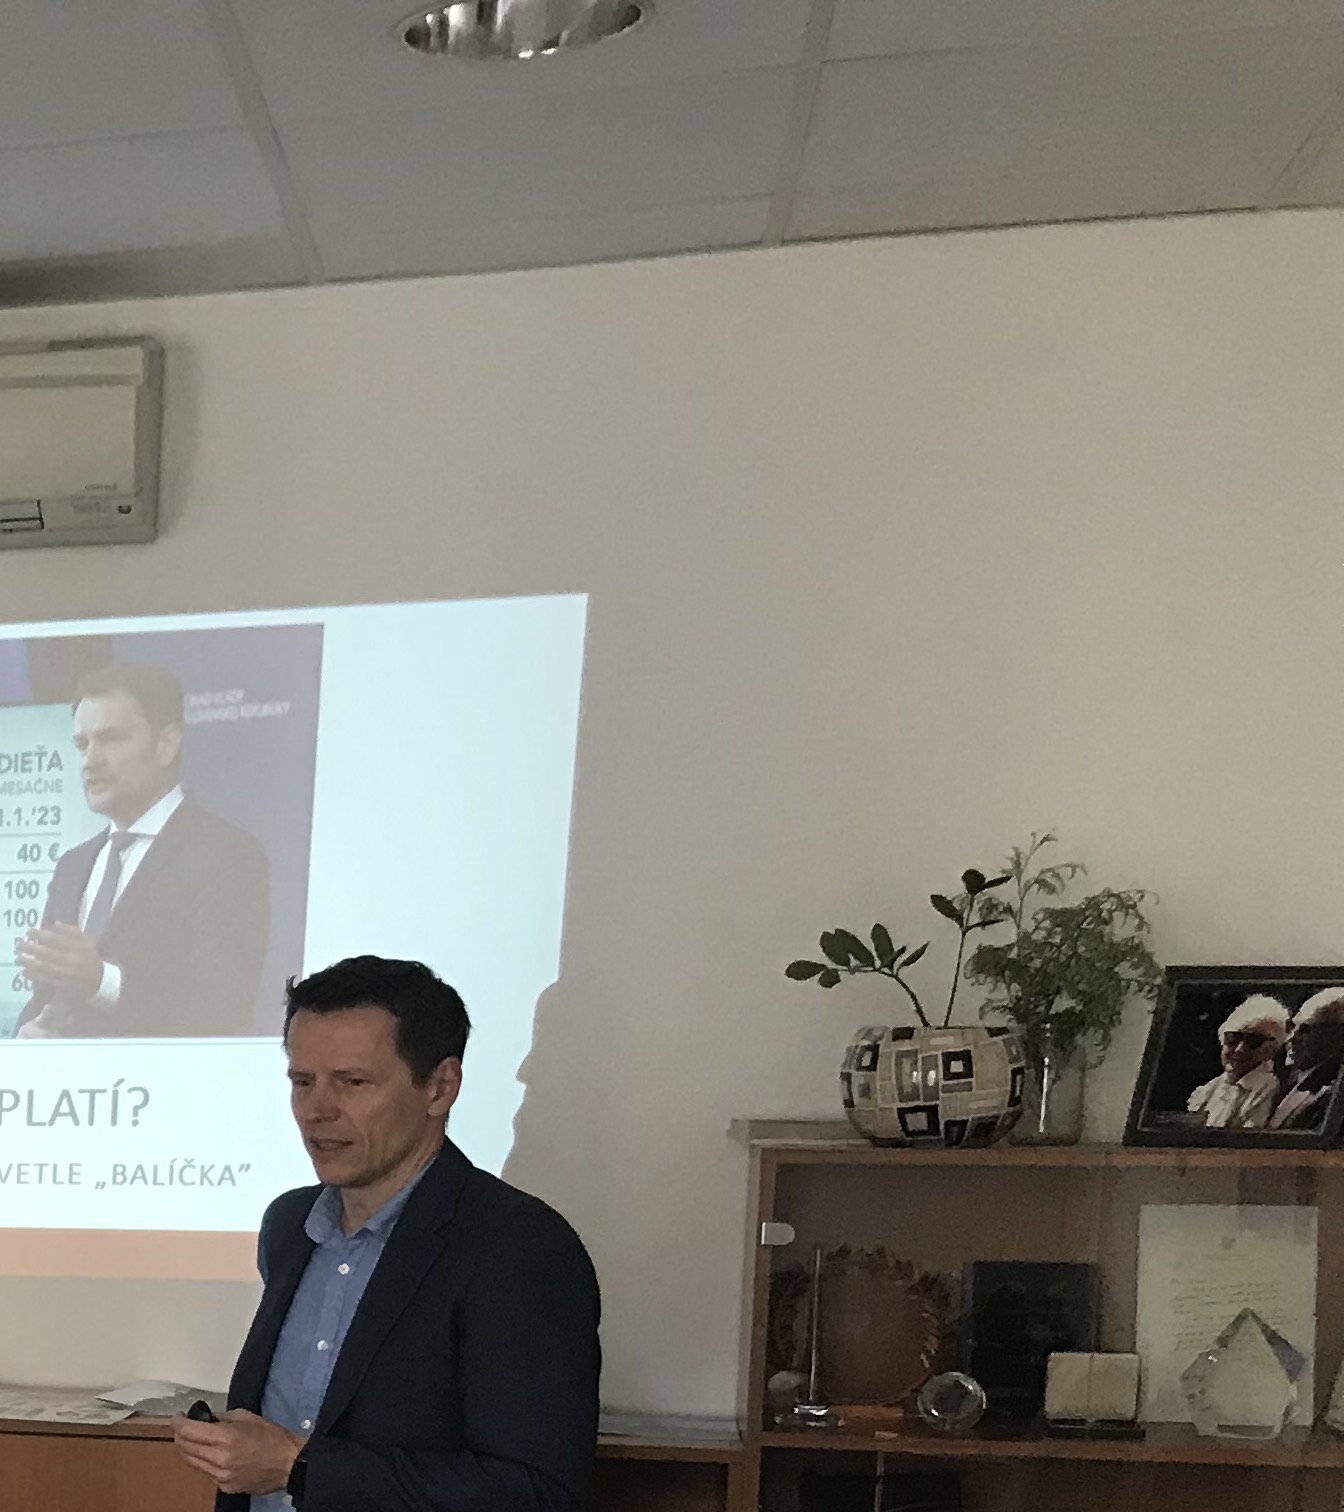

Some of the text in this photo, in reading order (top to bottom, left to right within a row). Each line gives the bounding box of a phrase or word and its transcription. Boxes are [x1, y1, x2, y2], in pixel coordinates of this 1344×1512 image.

[17, 843, 60, 863] 40 €
[4, 879, 40, 899] 100
[3, 908, 38, 927] 100
